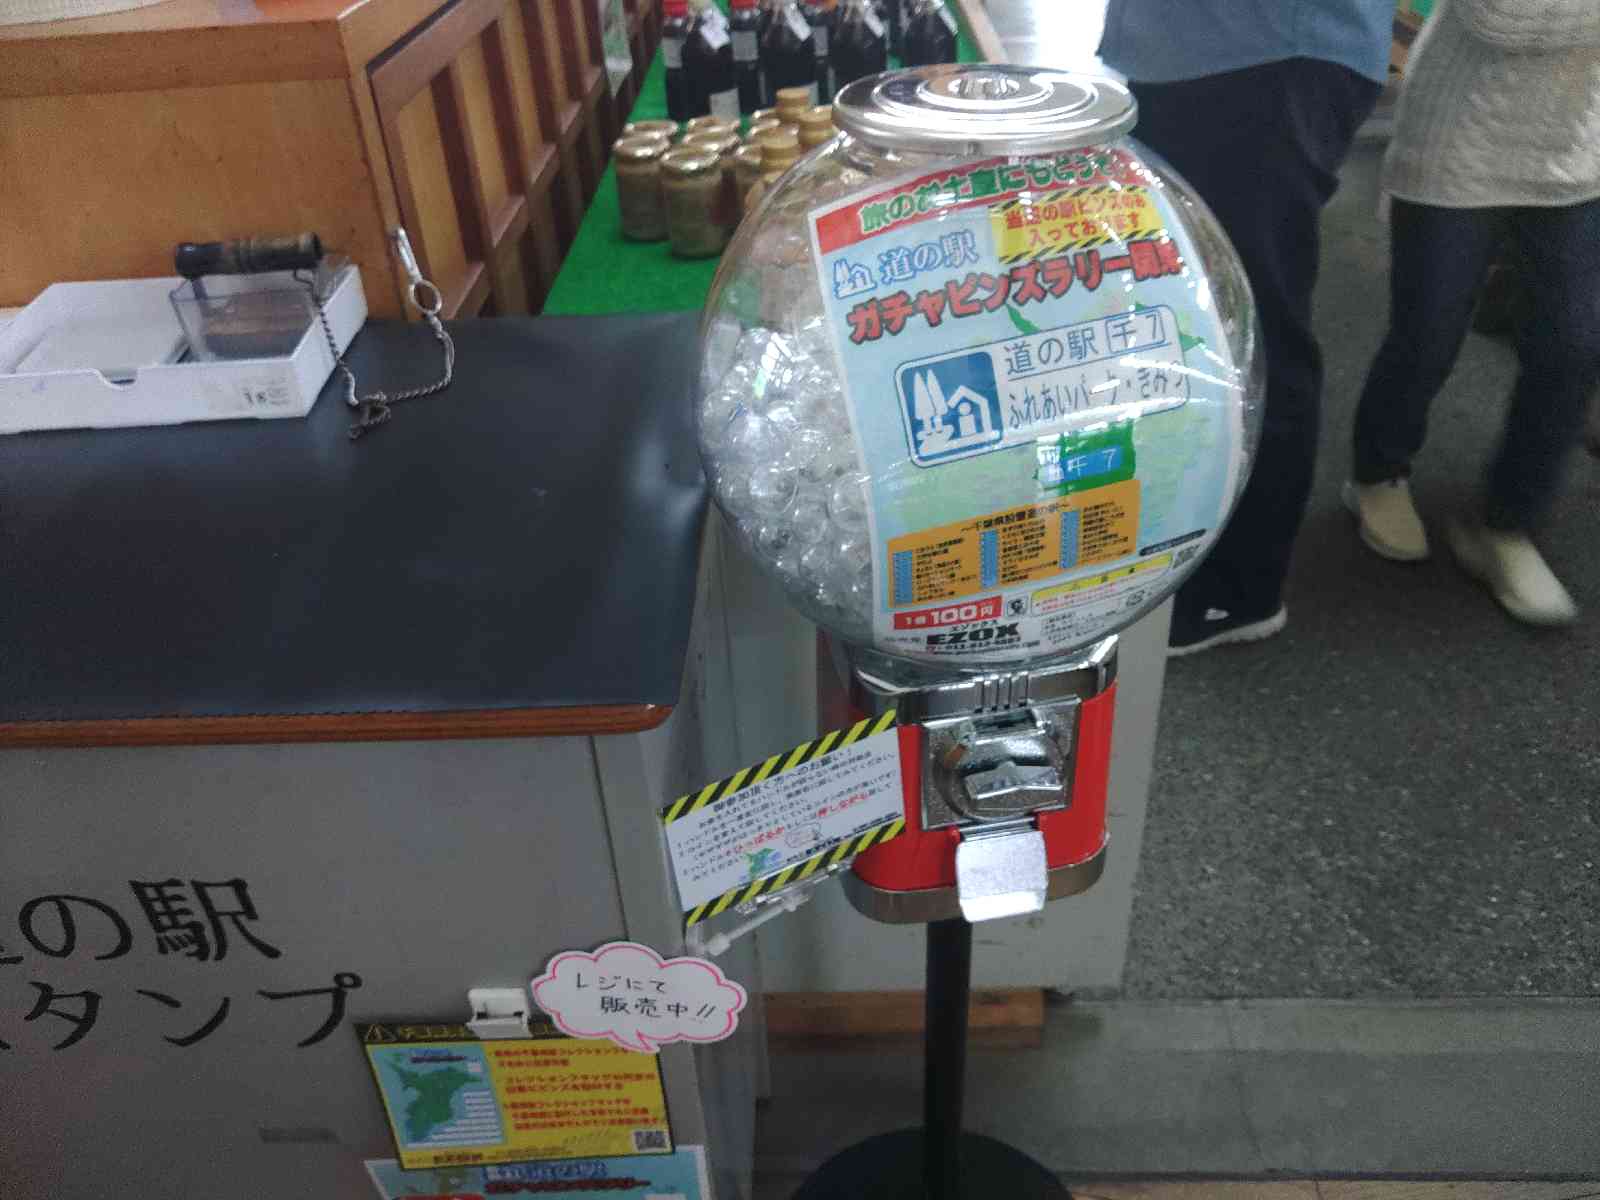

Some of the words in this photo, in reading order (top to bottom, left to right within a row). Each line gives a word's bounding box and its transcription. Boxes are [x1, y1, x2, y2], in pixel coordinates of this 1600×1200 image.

[878, 230, 979, 284] 道の駅
[1004, 326, 1099, 376] 道の駅
[926, 623, 1020, 645] EZOX
[0, 878, 282, 961] の駅
[576, 972, 667, 994] レジにて
[0, 972, 362, 1050] タンプ
